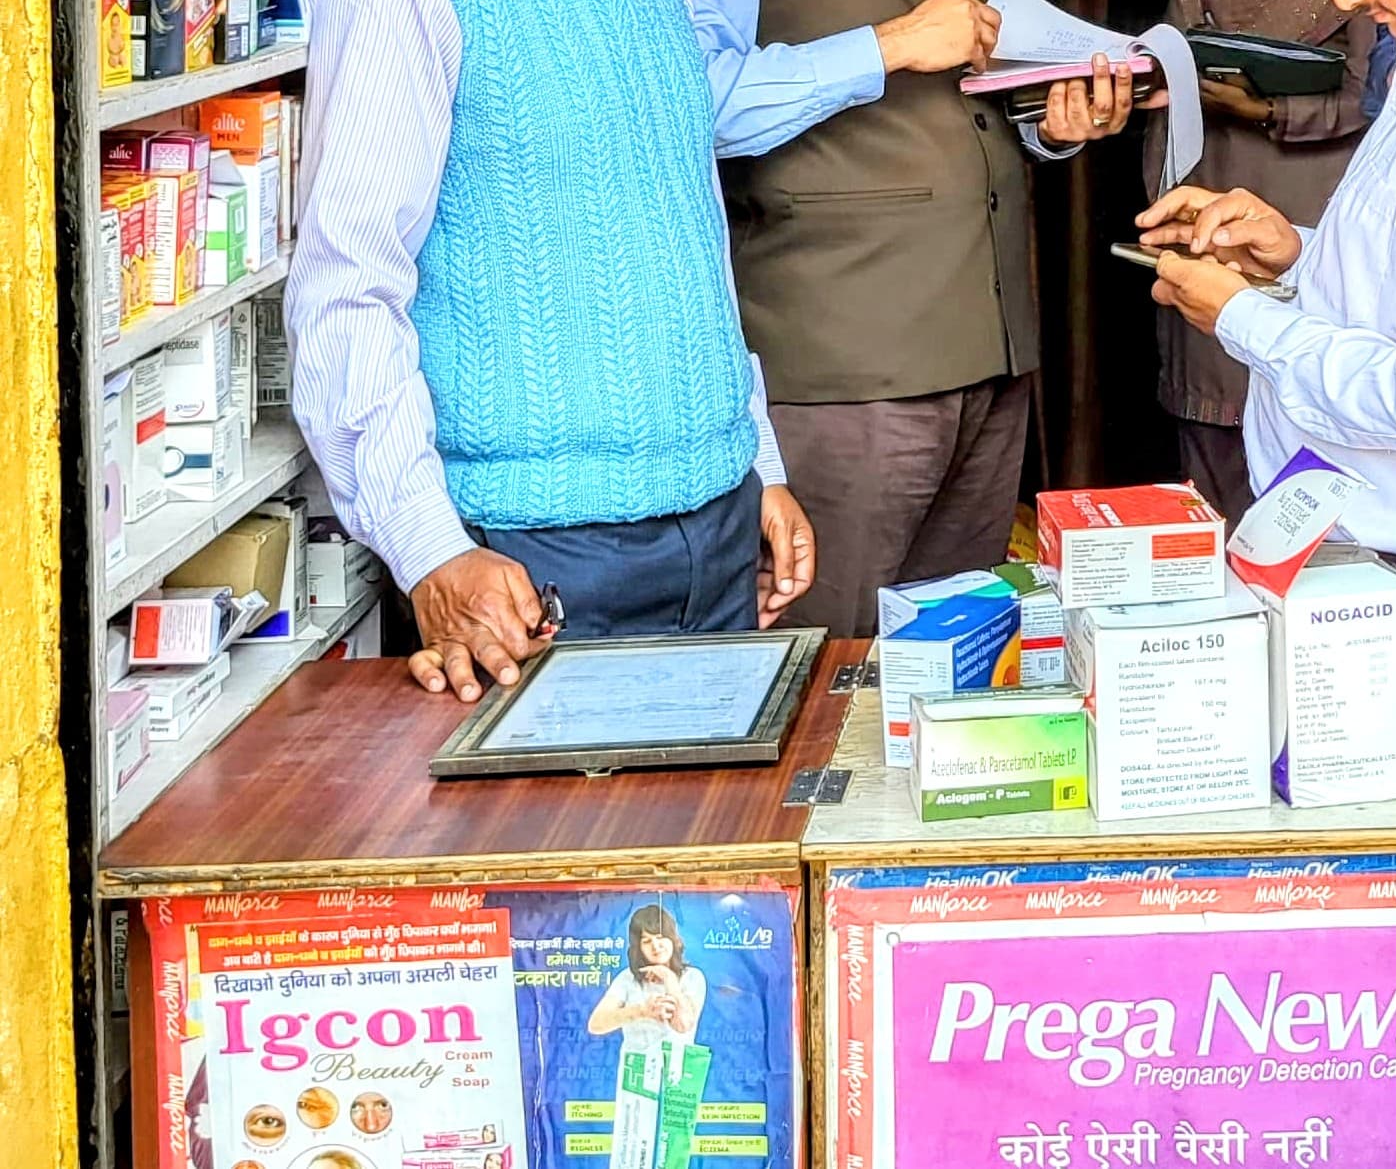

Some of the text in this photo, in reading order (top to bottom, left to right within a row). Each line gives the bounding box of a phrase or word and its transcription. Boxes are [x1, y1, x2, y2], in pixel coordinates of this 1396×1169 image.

[216, 132, 240, 143] MEN
[1310, 603, 1394, 625] NOGACID
[1140, 633, 1225, 654] Aciloc 150
[930, 752, 979, 777] Aceclofenac
[988, 753, 1037, 774] Paracetamol
[1037, 749, 1066, 770] Tablets
[204, 893, 285, 919] MANforce
[910, 891, 992, 919] MANforce
[1025, 886, 1106, 915] MANforce
[1140, 883, 1221, 910] MANforce
[1254, 880, 1336, 908] MANforce
[214, 971, 274, 995] दिखाओ
[278, 970, 326, 998] दुनिया
[330, 966, 353, 988] को
[357, 968, 402, 986] अपना
[405, 961, 456, 984] असली
[458, 963, 498, 982] चेहरा
[215, 997, 483, 1074] Igcon
[928, 980, 1177, 1088] Prega
[444, 1048, 494, 1063] Cream
[463, 1063, 476, 1074] &
[310, 1051, 447, 1091] Beauty
[450, 1074, 492, 1090] Soap
[1133, 1062, 1254, 1091] Pregnancy
[1257, 1054, 1363, 1083] Detection
[997, 1114, 1335, 1168] कोई ऐसी वैसी नहीं
